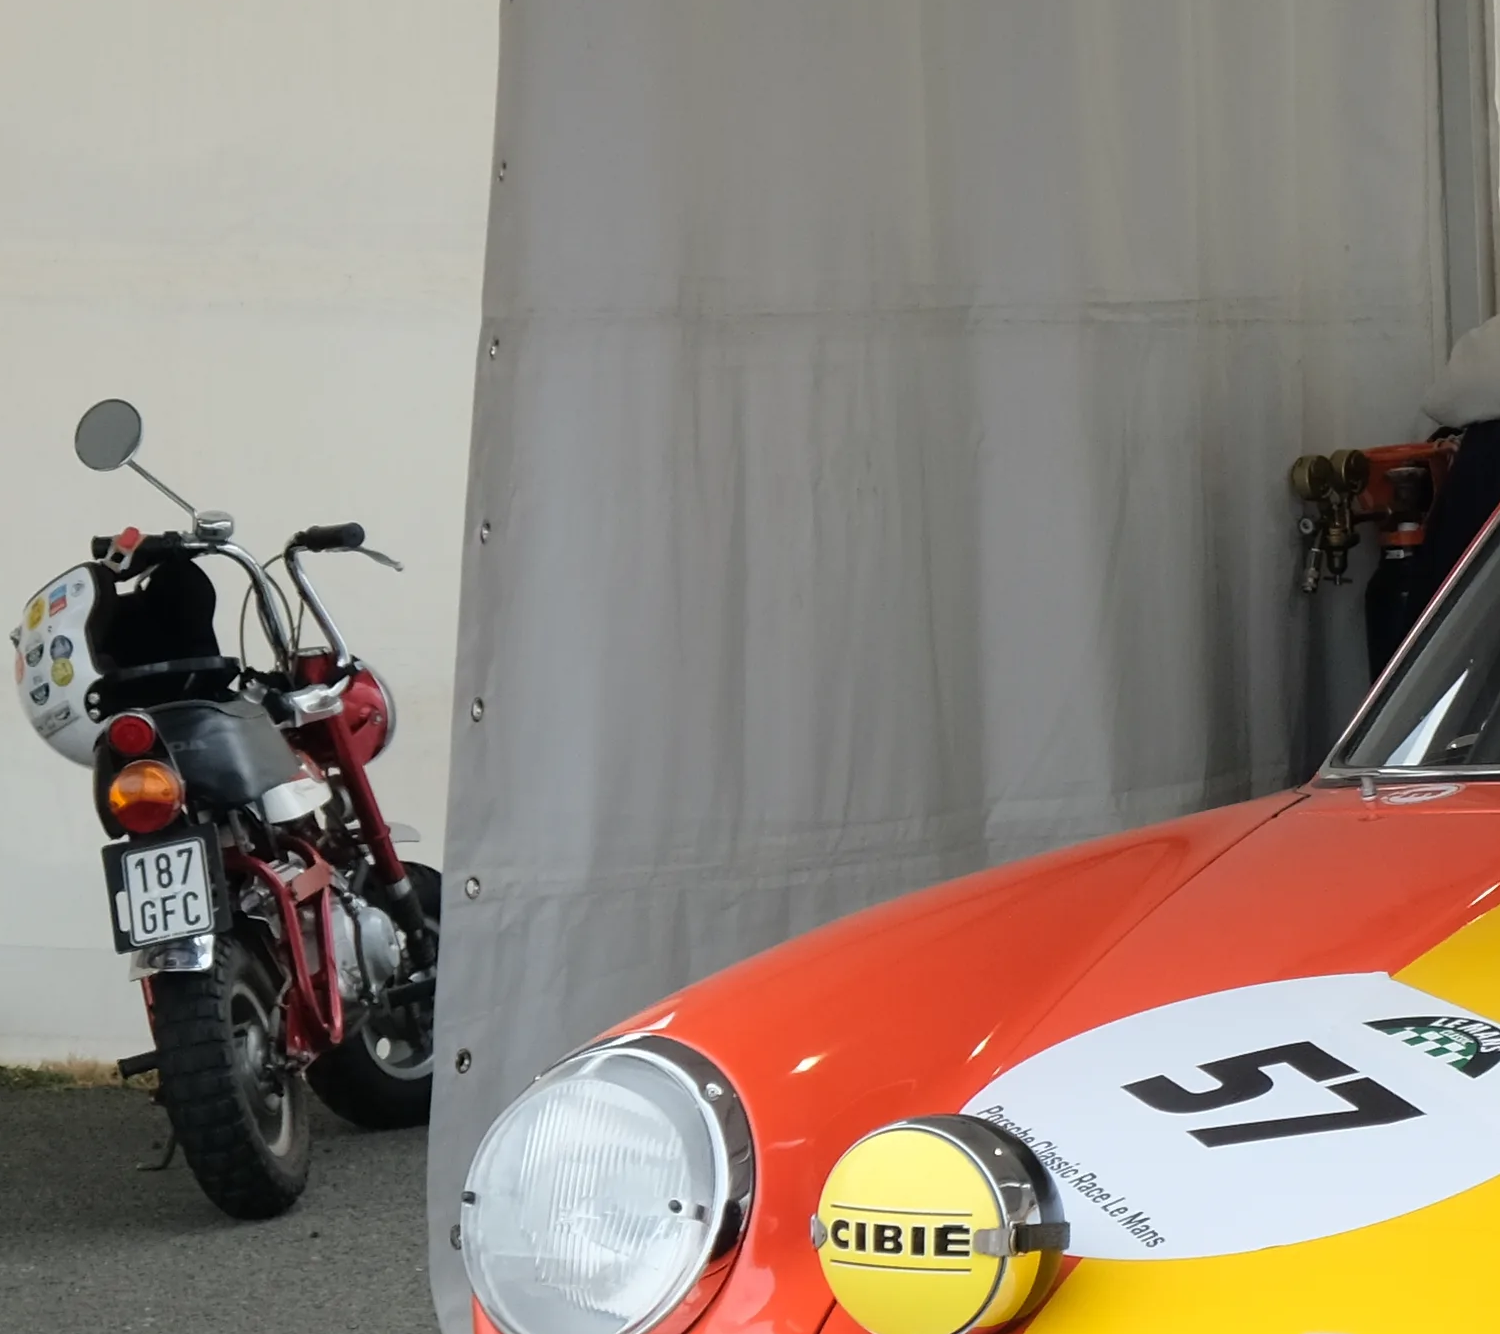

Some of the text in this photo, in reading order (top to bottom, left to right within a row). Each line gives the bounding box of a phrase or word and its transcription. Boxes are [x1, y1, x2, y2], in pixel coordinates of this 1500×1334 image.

[134, 846, 194, 893] 187
[140, 890, 202, 934] GFC
[1429, 1017, 1469, 1029] LE
[1120, 1041, 1427, 1149] 57
[977, 1104, 1167, 1249] Porsche Classic Race Le Mans
